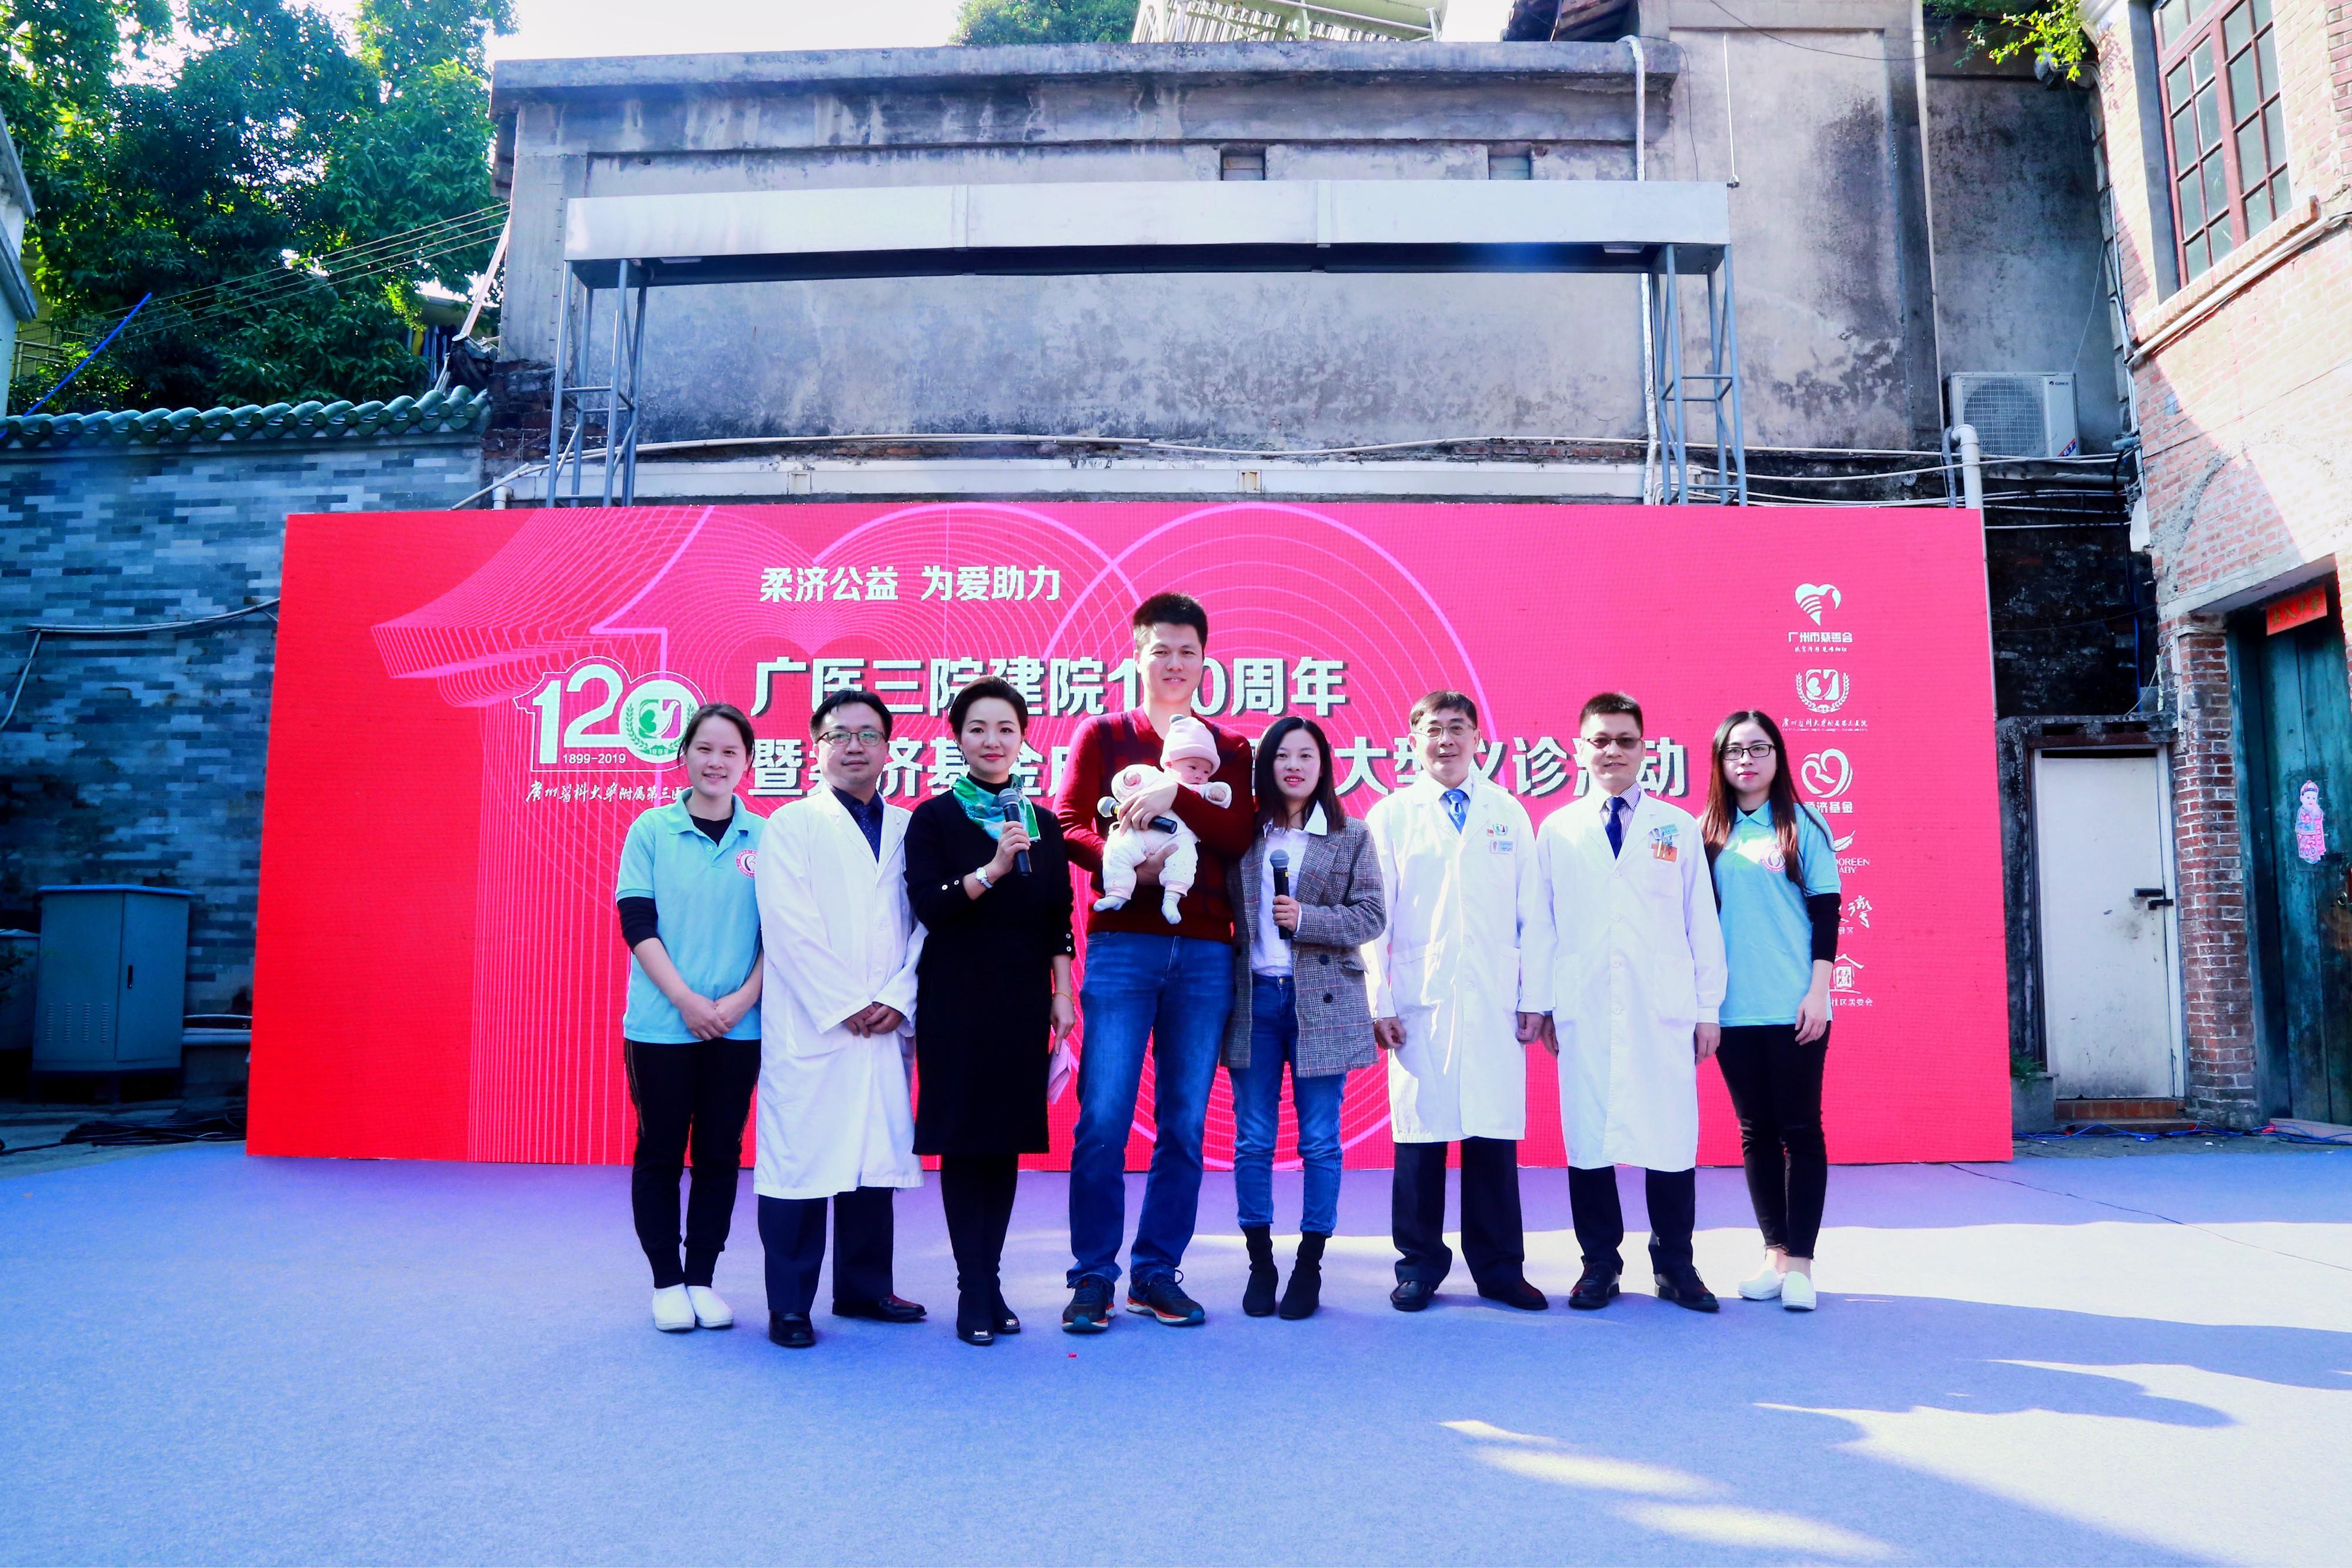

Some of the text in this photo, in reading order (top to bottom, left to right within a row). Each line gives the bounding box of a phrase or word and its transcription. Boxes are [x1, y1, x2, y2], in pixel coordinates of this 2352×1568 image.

[760, 565, 1060, 602] 柔济公益 为爱助力
[1788, 631, 1853, 643] 广州市慈善会
[750, 656, 1347, 717] 广医三院建院10周年
[562, 753, 626, 764] 1899-2019
